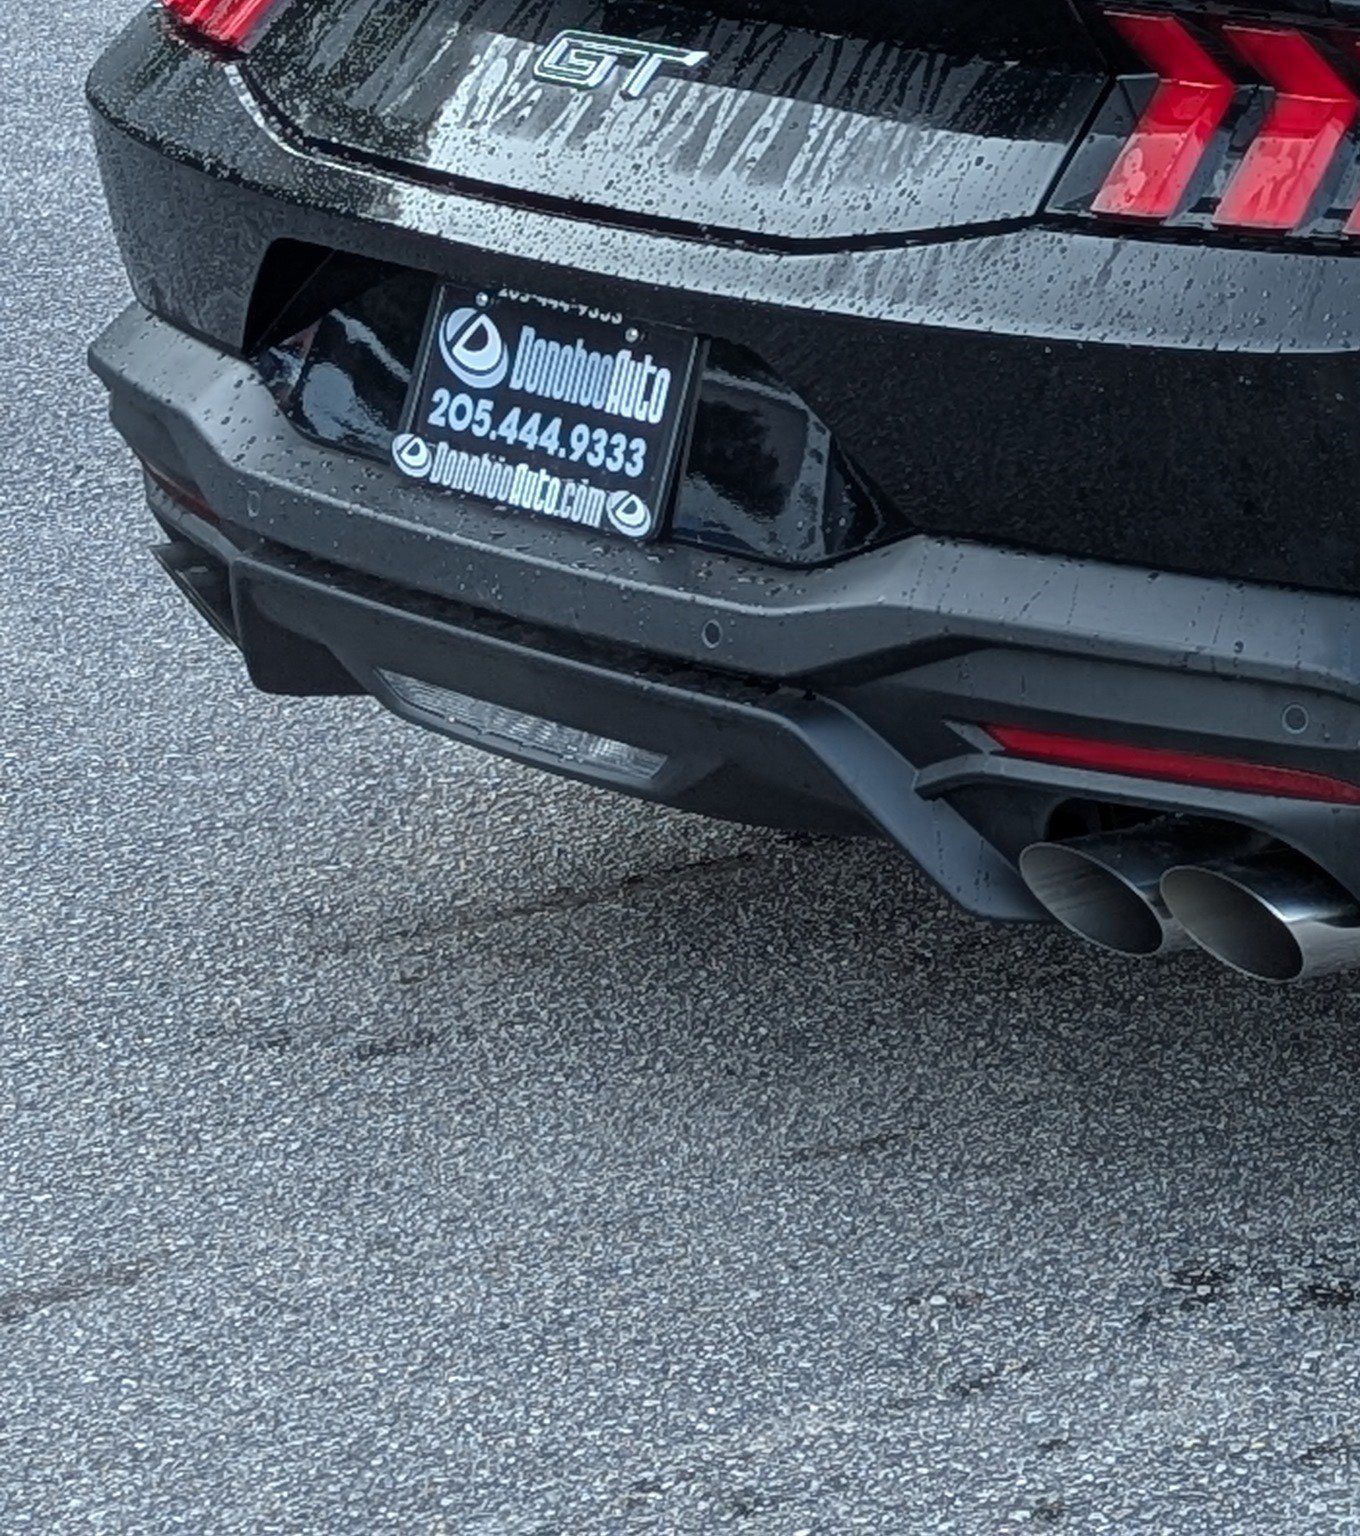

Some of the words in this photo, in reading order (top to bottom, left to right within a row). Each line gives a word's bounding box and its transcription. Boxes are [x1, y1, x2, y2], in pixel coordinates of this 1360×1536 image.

[533, 29, 709, 101] GT
[509, 325, 672, 425] DonohooAuto
[427, 387, 647, 478] 205.444.9333
[429, 440, 607, 529] DonohooAuto.com
